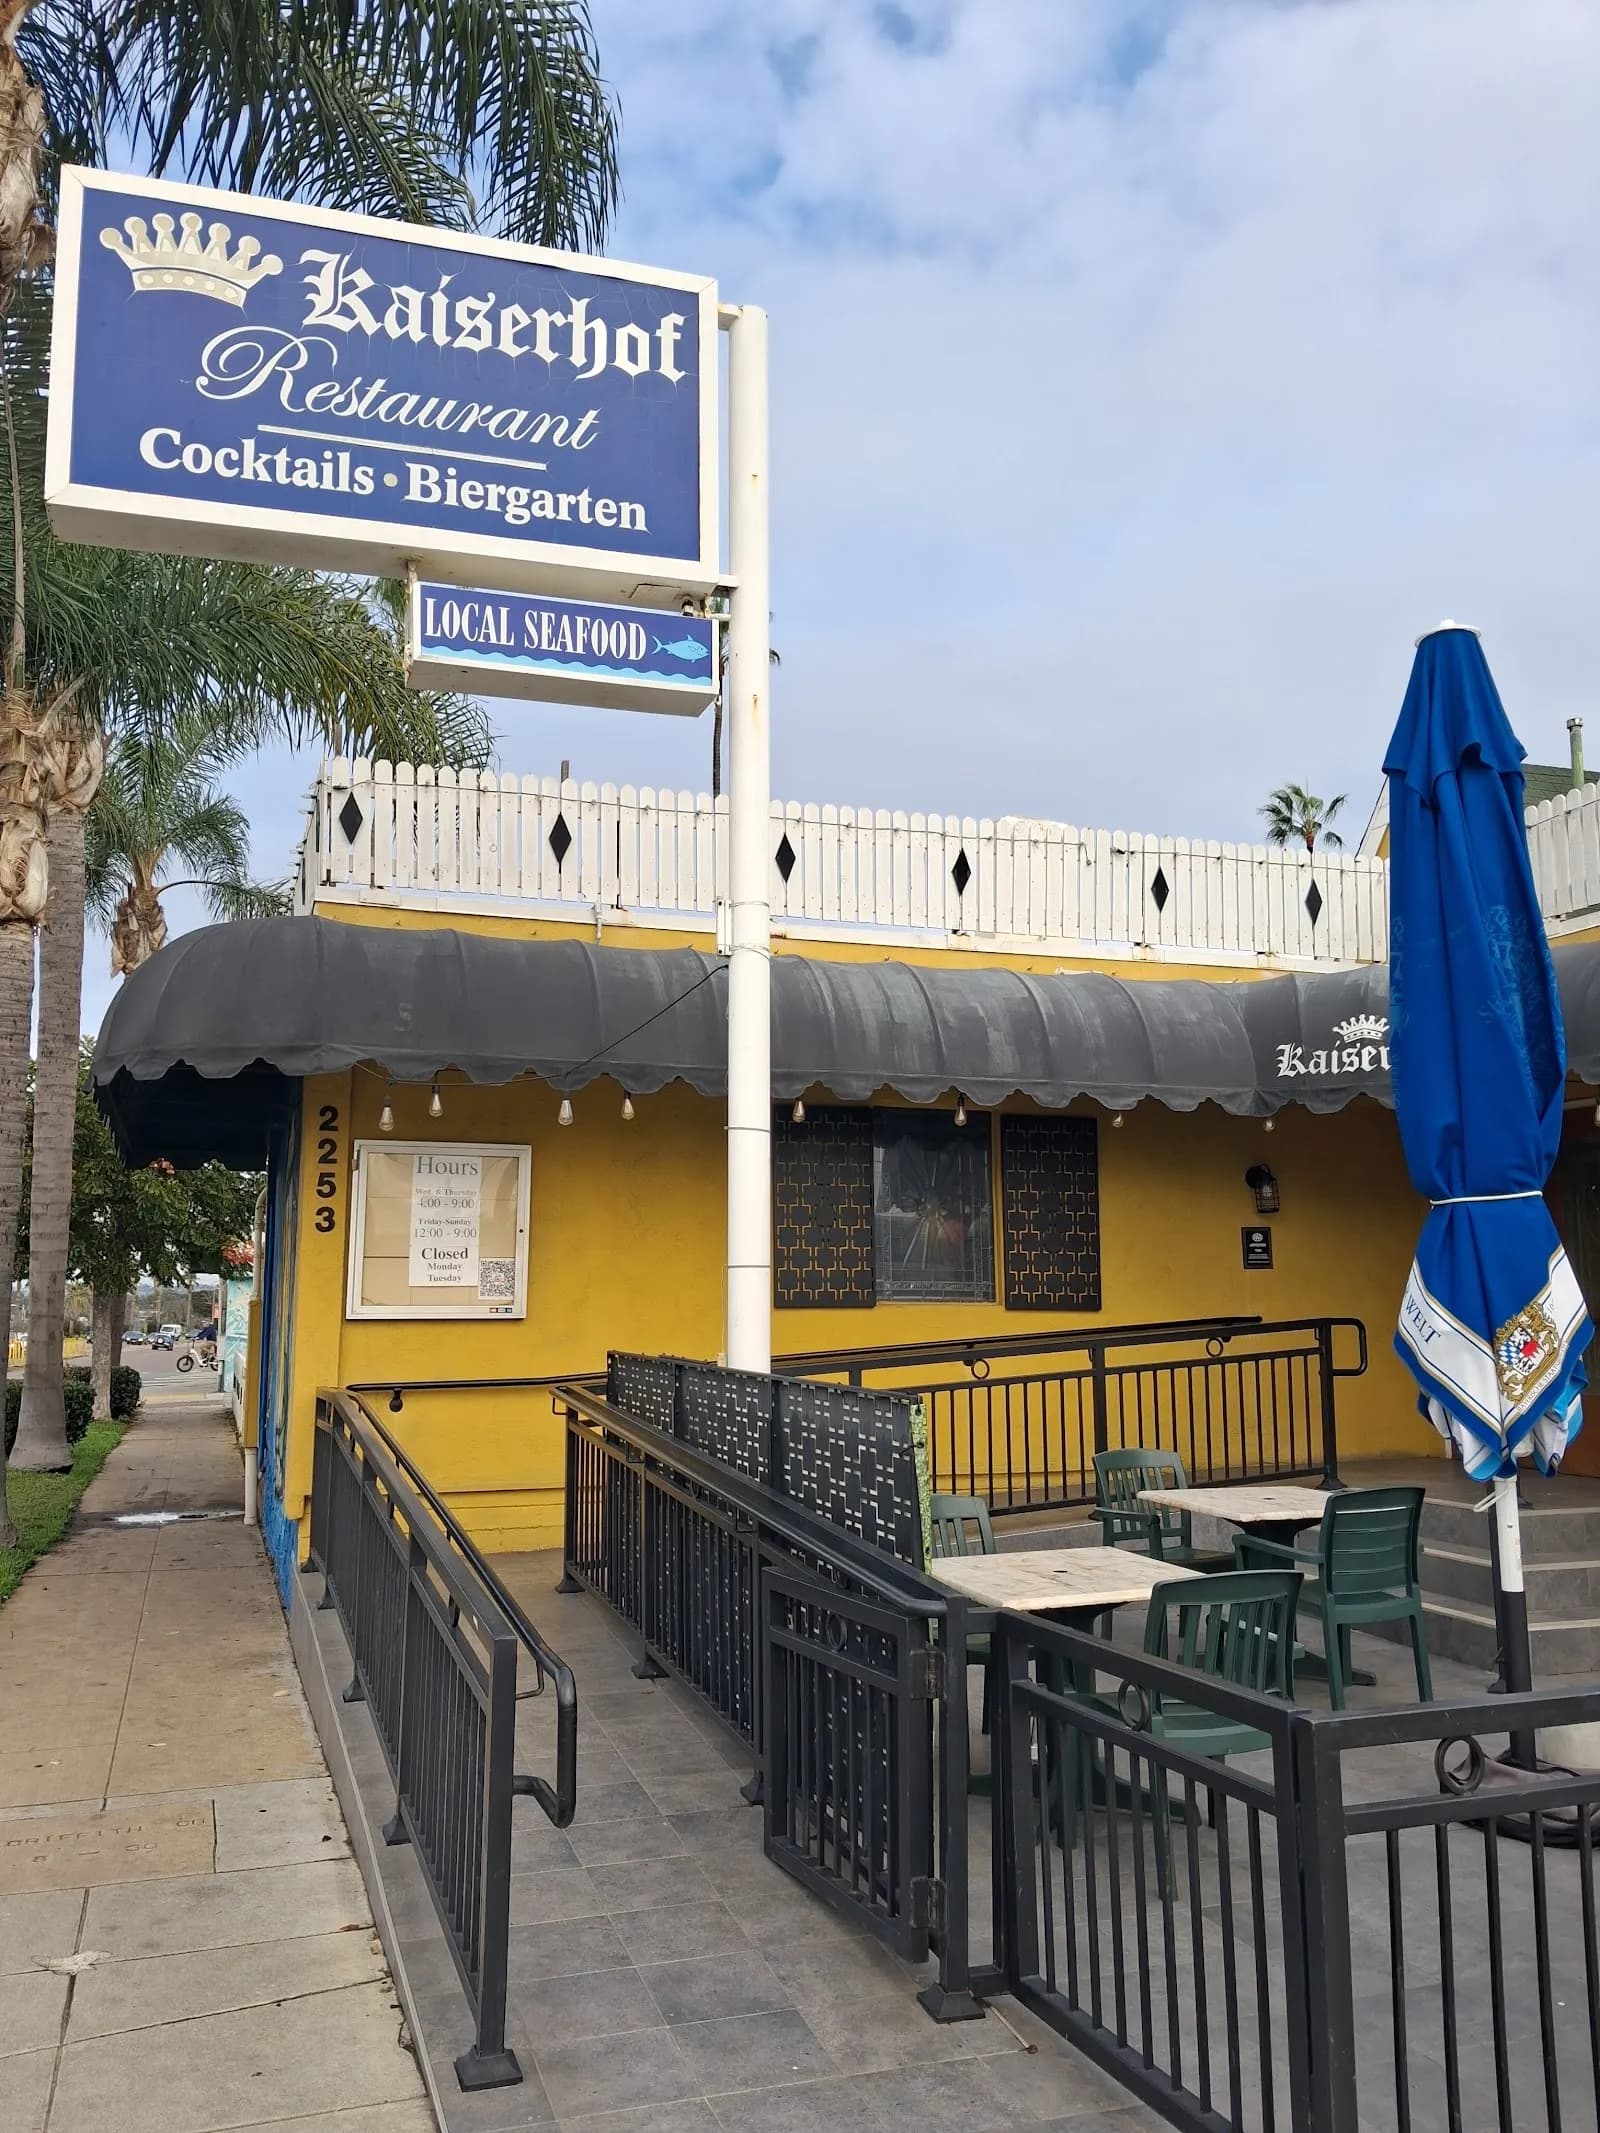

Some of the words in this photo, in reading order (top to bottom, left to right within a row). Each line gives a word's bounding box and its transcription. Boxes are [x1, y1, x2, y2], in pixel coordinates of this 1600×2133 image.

[300, 249, 686, 383] Kaiserhof
[195, 326, 600, 450] Restaurant
[139, 427, 375, 495] Cocktails
[403, 462, 649, 531] Biergarten
[423, 597, 515, 646] LOCAL
[523, 609, 648, 661] SEAFOOD
[314, 1105, 339, 1233] 2253
[415, 1156, 479, 1176] Hours
[416, 1198, 441, 1209] 4:00
[451, 1199, 475, 1209] 9:00
[415, 1228, 443, 1238] 12:00
[454, 1228, 477, 1238] 9:00
[421, 1247, 469, 1260] Closed
[427, 1262, 463, 1272] Monday
[428, 1273, 462, 1283] Tuesday
[1405, 1294, 1442, 1345] WELT
